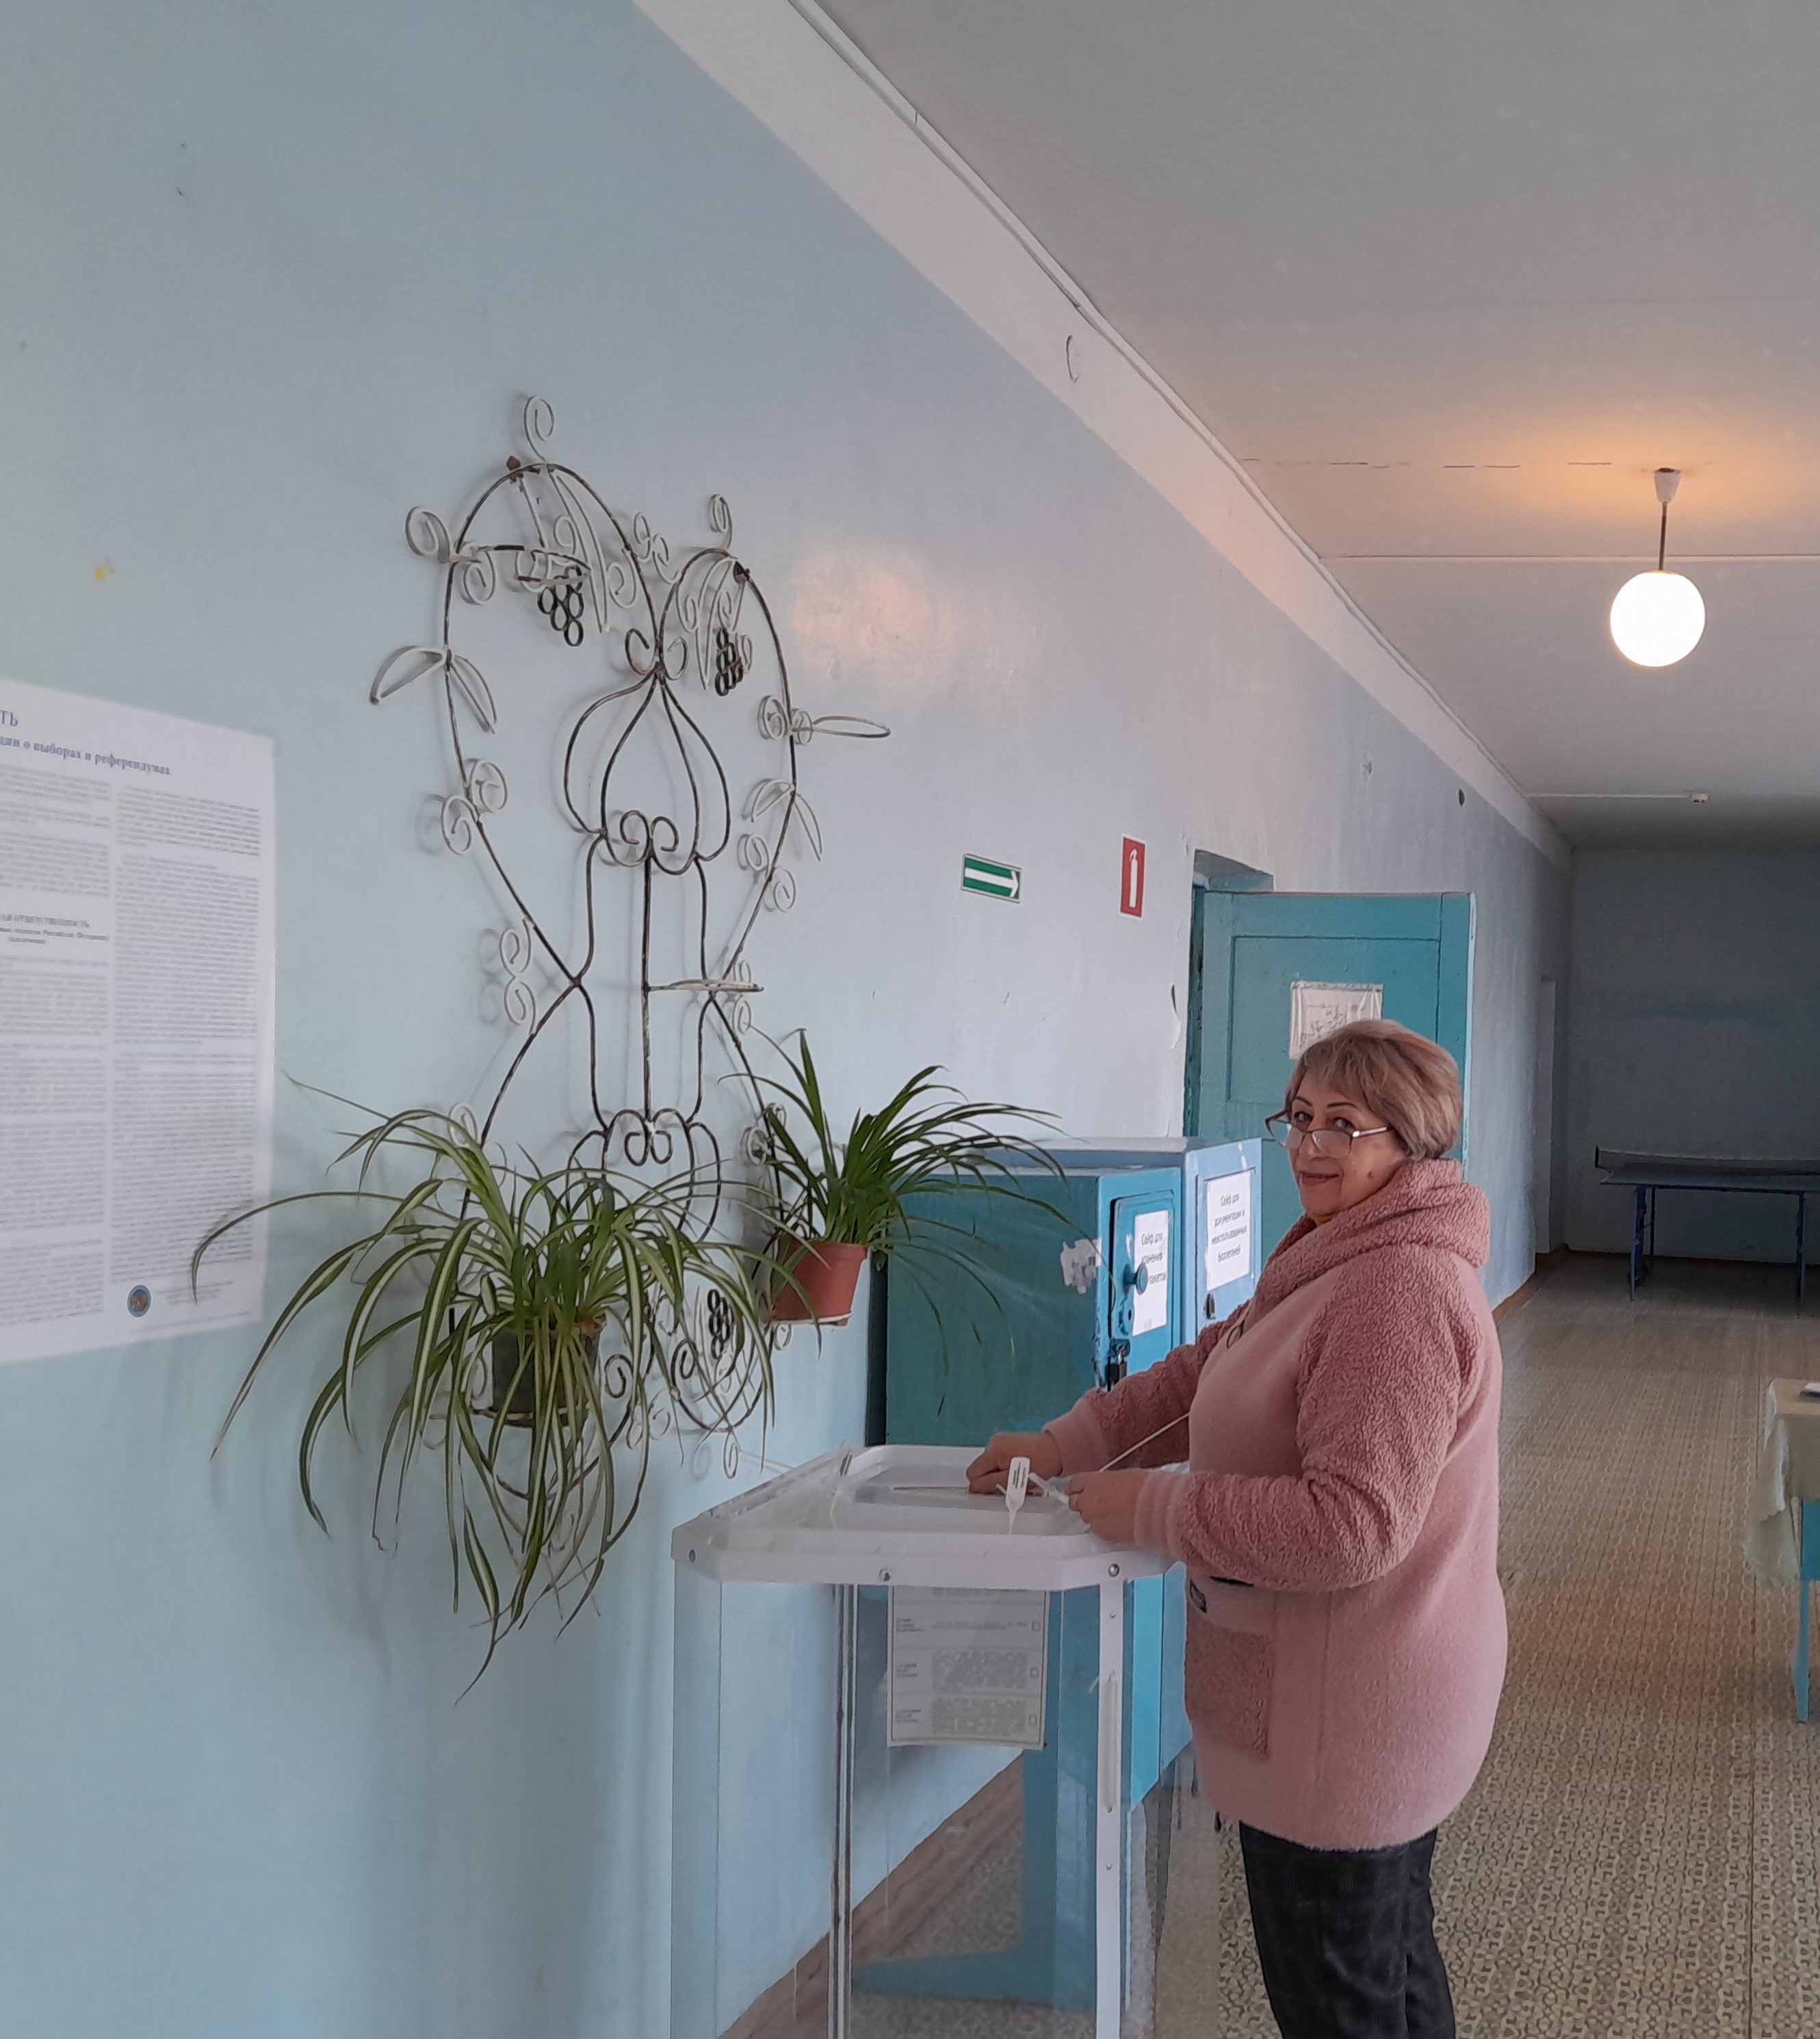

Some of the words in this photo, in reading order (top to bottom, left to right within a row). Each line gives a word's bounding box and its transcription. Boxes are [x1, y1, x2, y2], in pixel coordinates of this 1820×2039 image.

[23, 741, 30, 749] о
[34, 742, 81, 759] выборах
[85, 753, 91, 761] и
[95, 753, 170, 775] референдумах
[1141, 1233, 1154, 1246] Сейф
